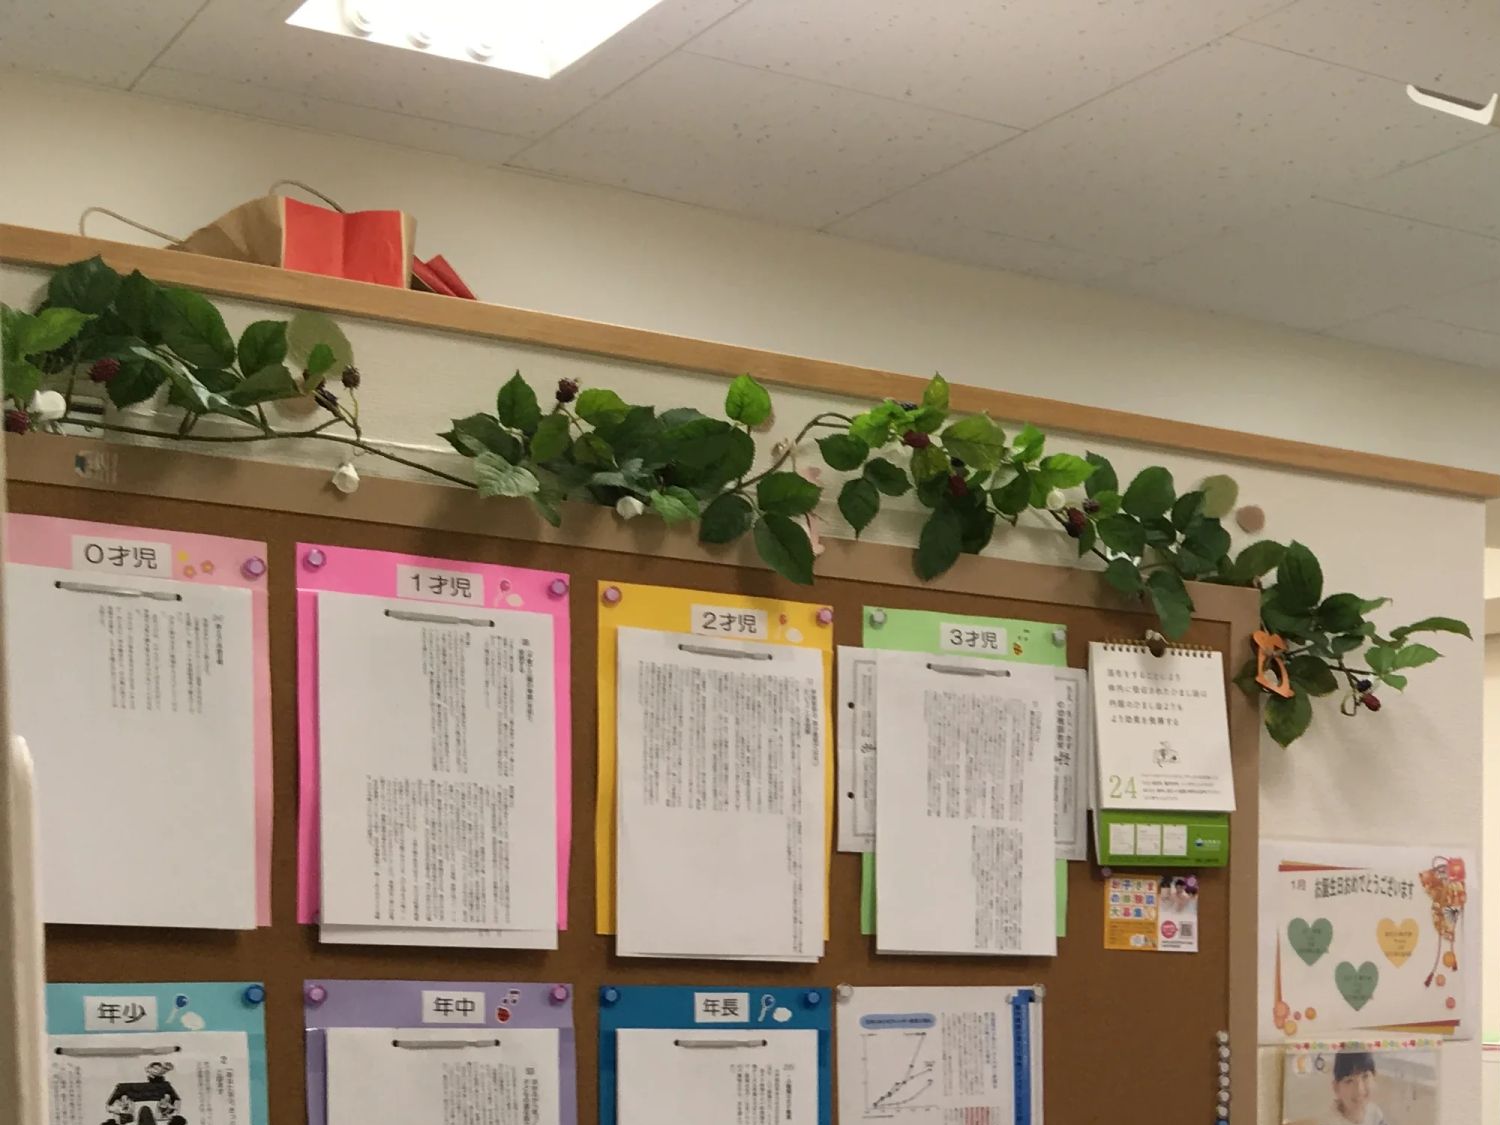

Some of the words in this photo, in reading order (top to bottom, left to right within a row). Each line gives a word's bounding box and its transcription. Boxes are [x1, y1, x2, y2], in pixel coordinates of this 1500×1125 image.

[84, 543, 158, 571] 0才児
[410, 573, 472, 599] 1才児
[701, 611, 758, 635] 2才児
[948, 627, 999, 650] 3才児
[1108, 774, 1138, 799] 24
[96, 1002, 147, 1025] 年少
[431, 997, 477, 1017] 年中
[702, 998, 741, 1018] 年長
